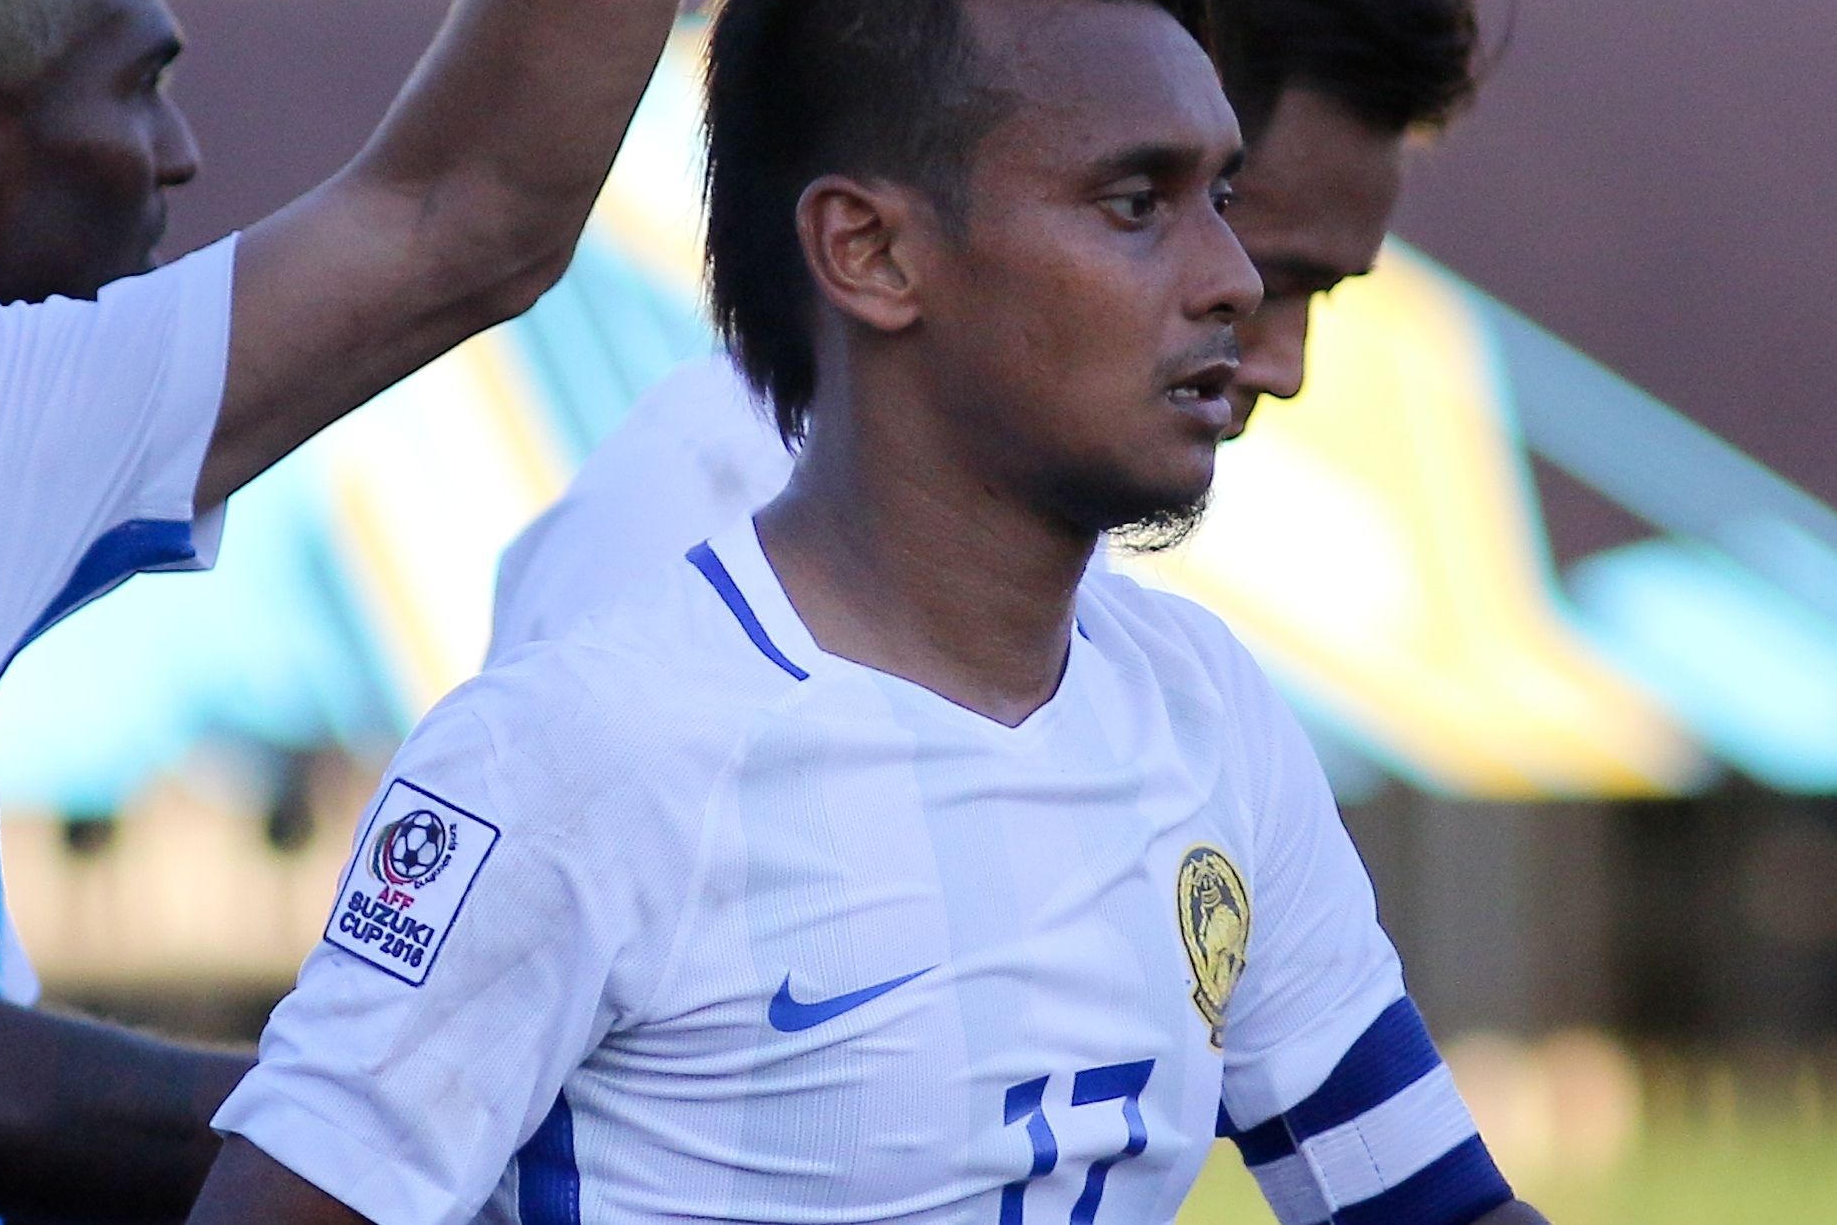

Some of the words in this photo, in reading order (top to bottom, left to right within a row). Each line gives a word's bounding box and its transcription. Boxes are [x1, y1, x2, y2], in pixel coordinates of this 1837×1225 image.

[348, 890, 435, 948] SUZUKI
[377, 885, 415, 911] AFF
[340, 911, 384, 943] CUP
[379, 932, 425, 967] 2016
[999, 1058, 1156, 1225] 17
